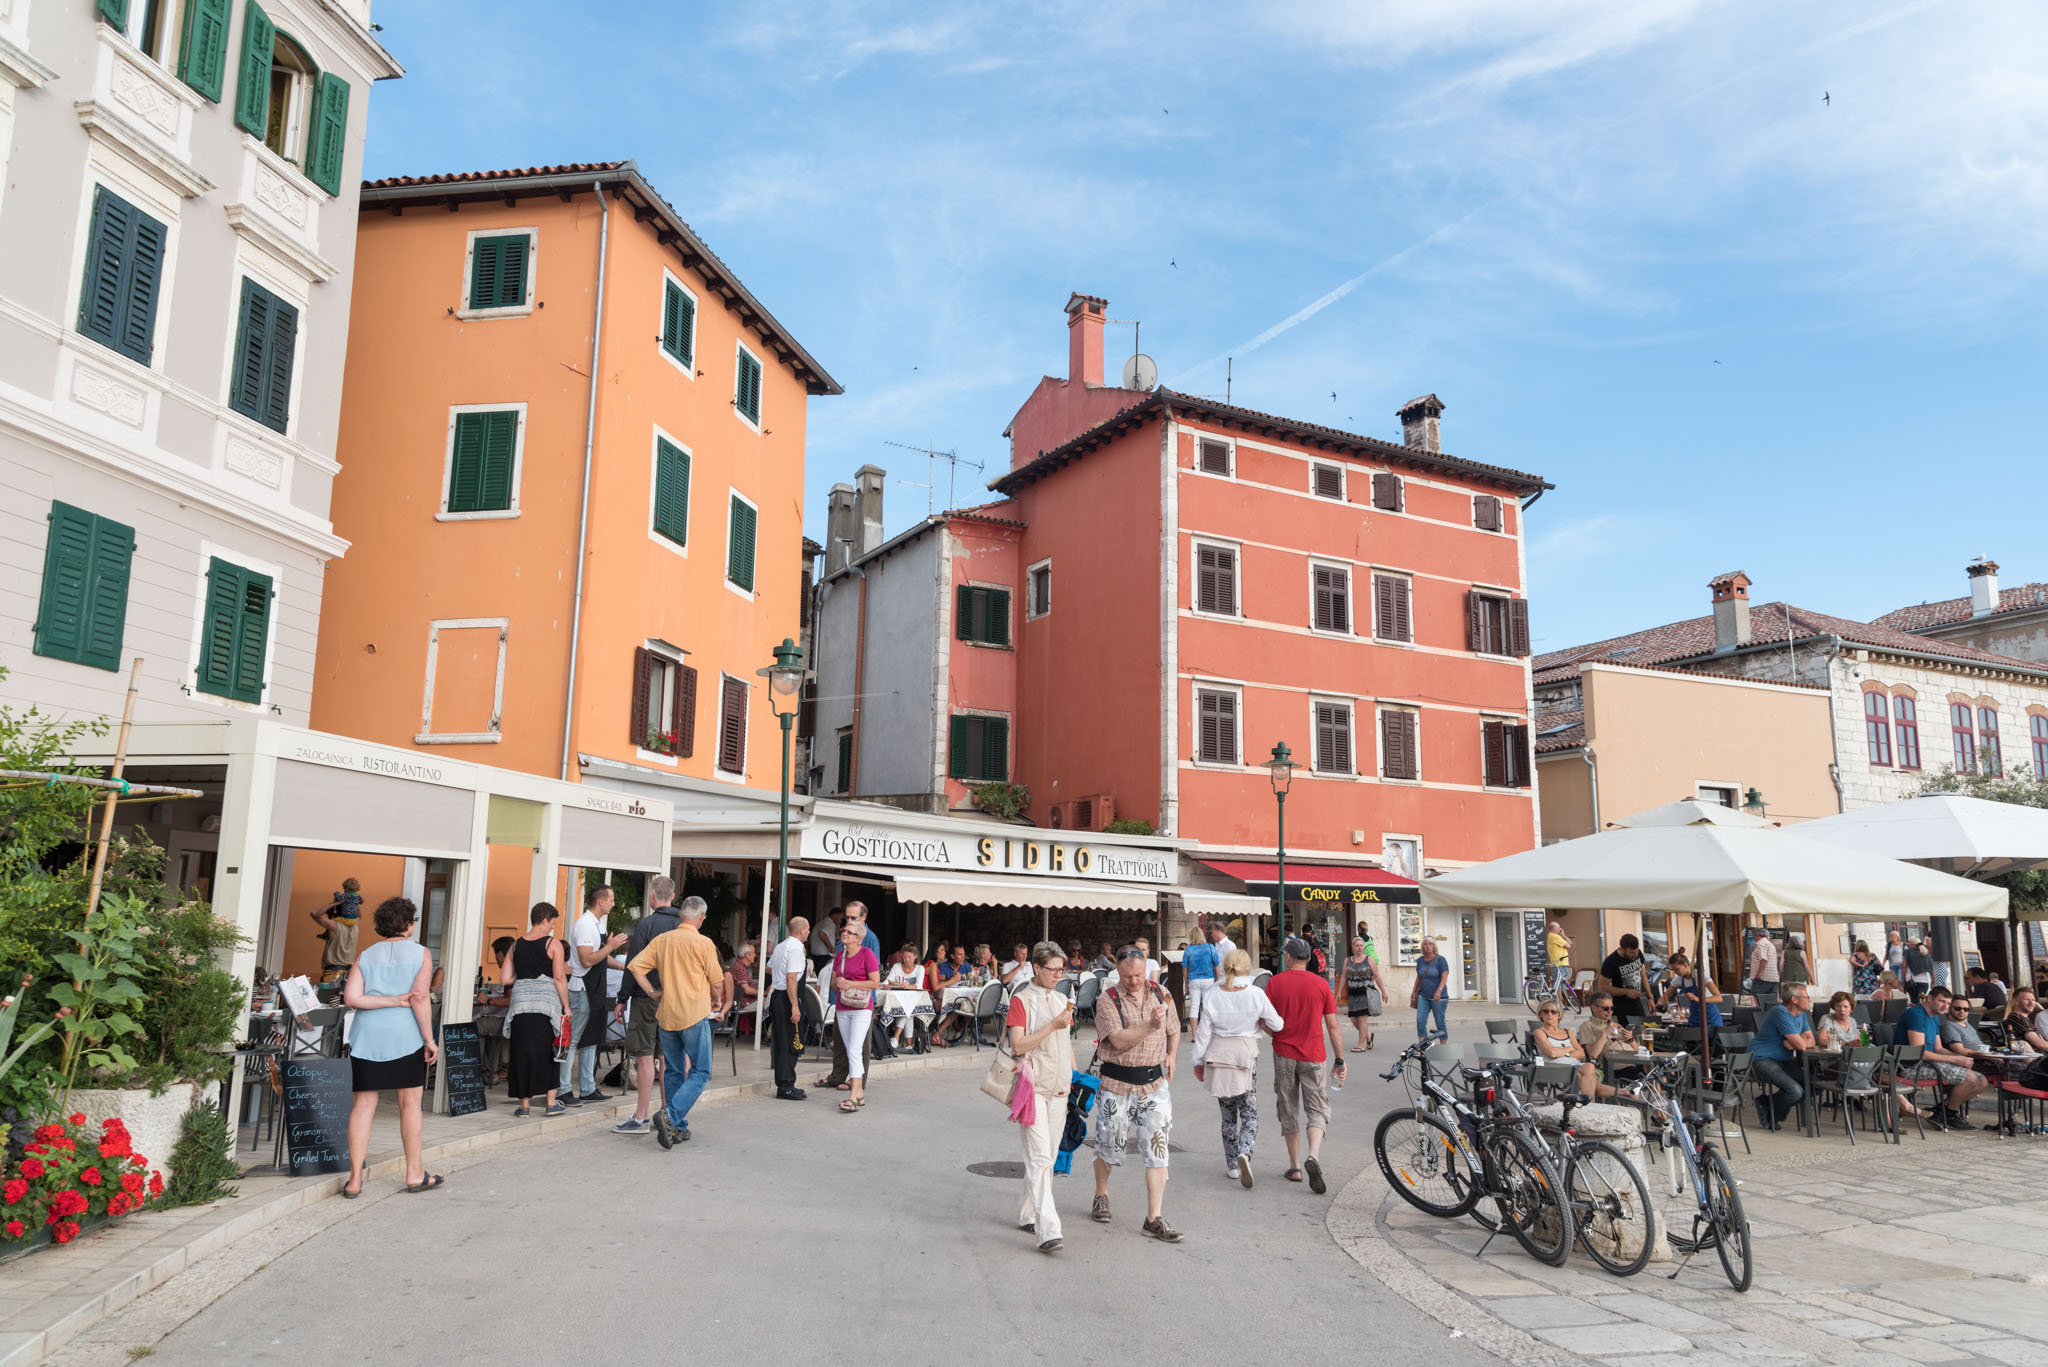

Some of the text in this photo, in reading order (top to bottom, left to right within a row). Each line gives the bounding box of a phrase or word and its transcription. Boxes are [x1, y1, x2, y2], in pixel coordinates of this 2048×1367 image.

[363, 756, 442, 781] RISTORANTINO
[586, 796, 609, 810] SNACK
[610, 801, 622, 812] BAR
[822, 829, 1169, 879] GOSTIONICA SIDRO TRATTORIA
[1301, 887, 1380, 903] CANDY BAR
[287, 1065, 329, 1081] Octopus
[288, 1088, 320, 1100] Cheese
[292, 1148, 319, 1169] Grilled
